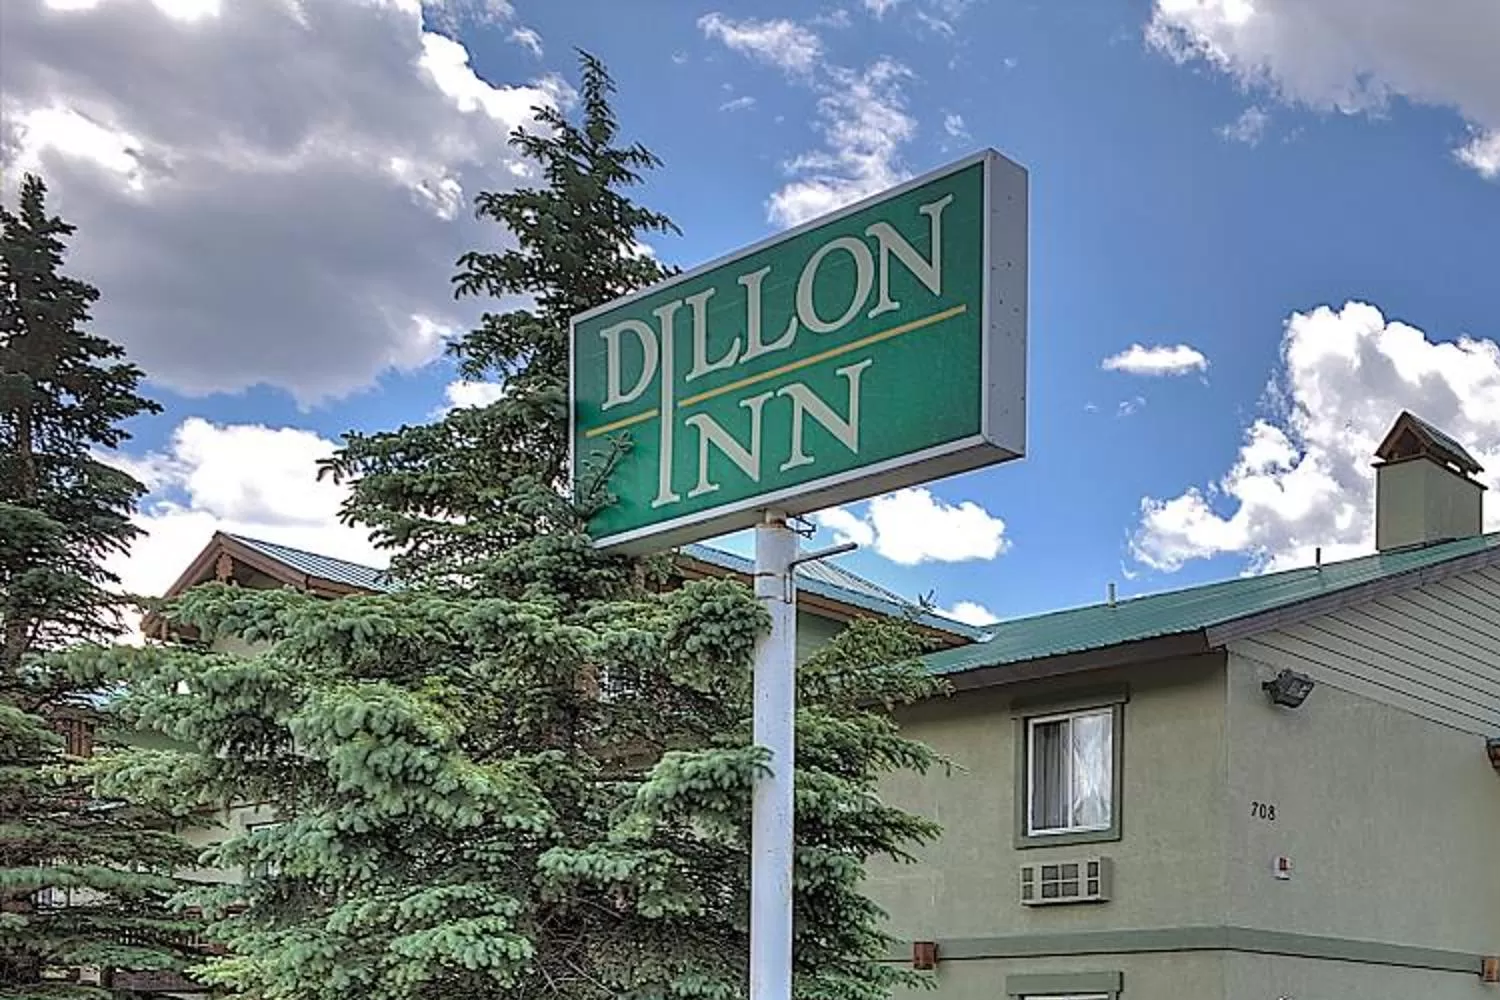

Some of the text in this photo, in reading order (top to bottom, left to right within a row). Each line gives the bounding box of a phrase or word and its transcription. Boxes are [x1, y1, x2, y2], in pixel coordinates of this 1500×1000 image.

[599, 193, 954, 412] DILLON
[651, 357, 873, 508] INN
[1251, 801, 1276, 821] 708
